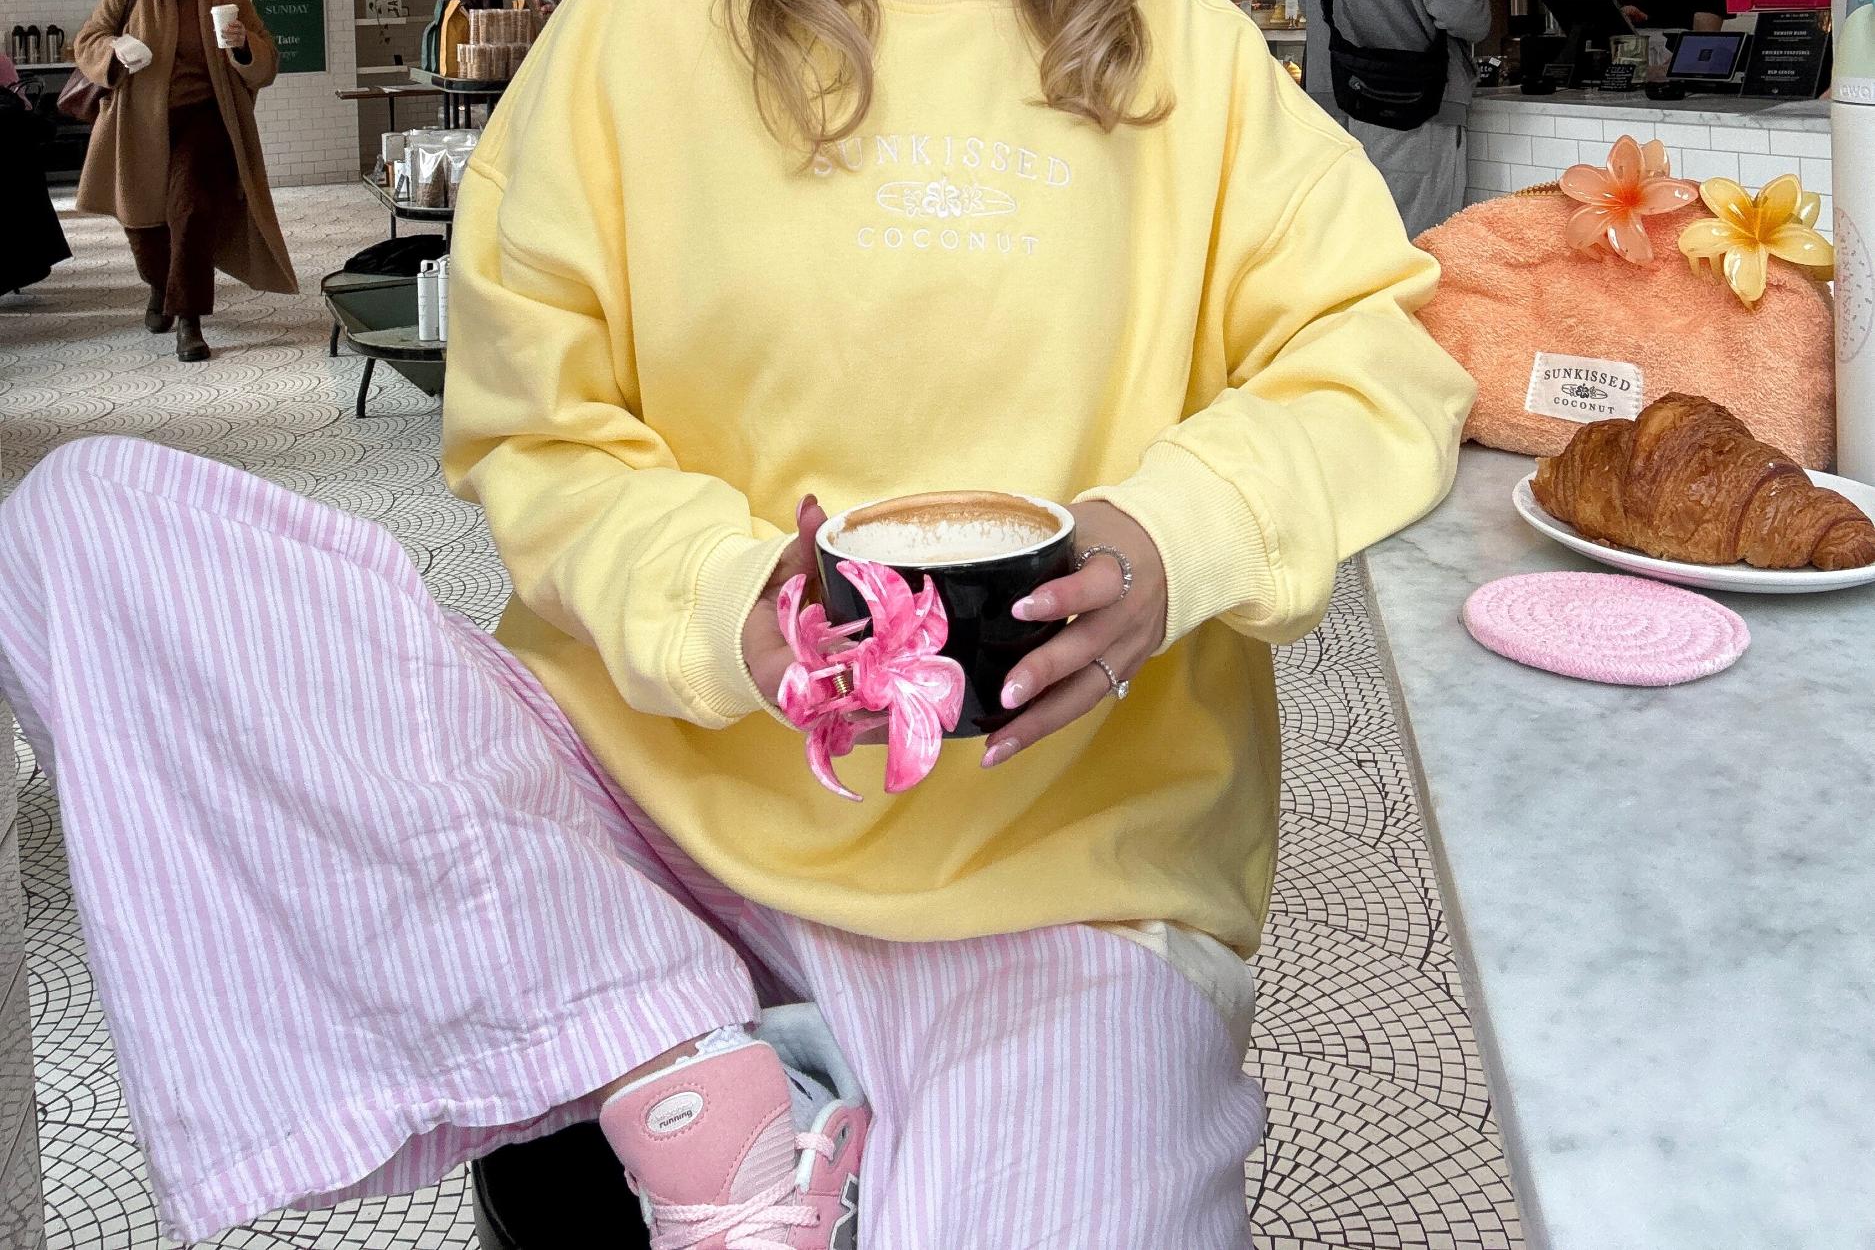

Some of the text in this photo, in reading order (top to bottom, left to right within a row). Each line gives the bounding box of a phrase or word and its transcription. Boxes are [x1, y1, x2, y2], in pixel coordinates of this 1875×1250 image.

[265, 4, 310, 15] SUNDAY
[277, 35, 300, 45] Tatte
[814, 134, 1073, 187] SUNKISSED
[857, 227, 1040, 256] COCONUT
[1543, 368, 1631, 392] SUNKISSED
[1553, 396, 1615, 414] COCONUT
[659, 1109, 693, 1129] running
